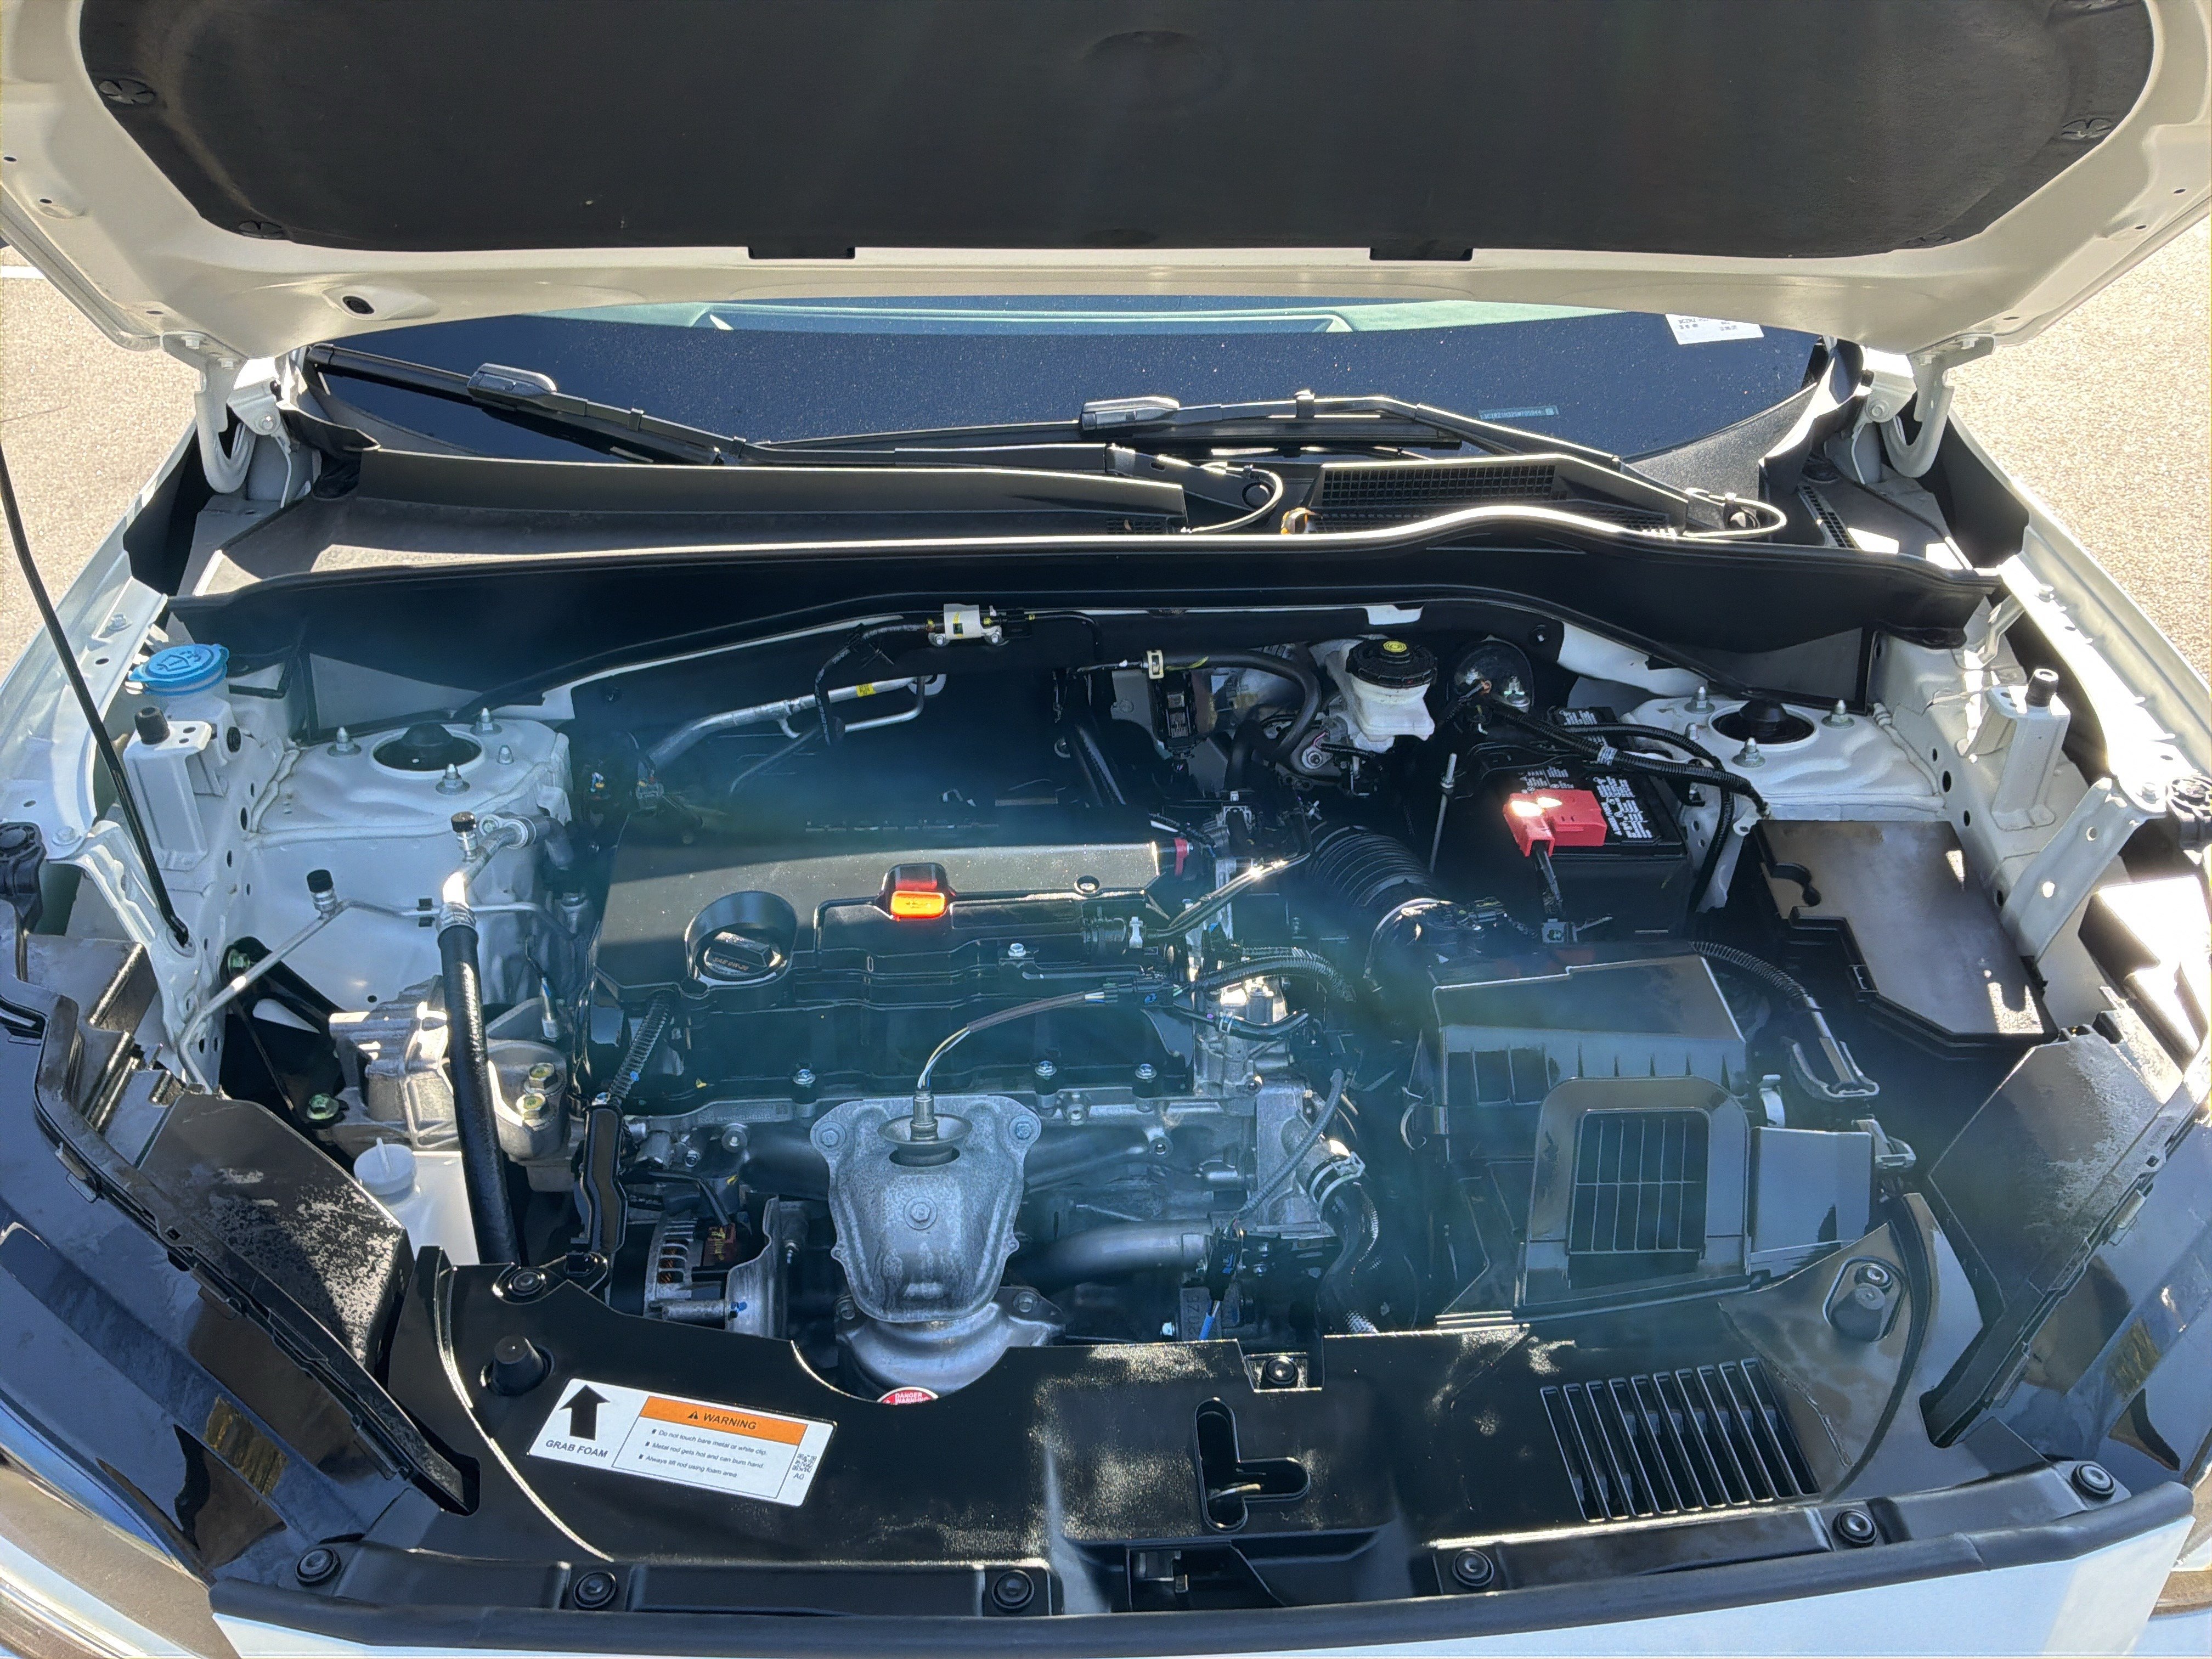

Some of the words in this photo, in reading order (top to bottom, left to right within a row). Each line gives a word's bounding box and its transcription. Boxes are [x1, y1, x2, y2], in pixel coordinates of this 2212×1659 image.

[703, 1412, 757, 1430] WARNING
[545, 1440, 576, 1452] GRAB
[577, 1446, 608, 1458] FOAM
[646, 1455, 667, 1464] Always
